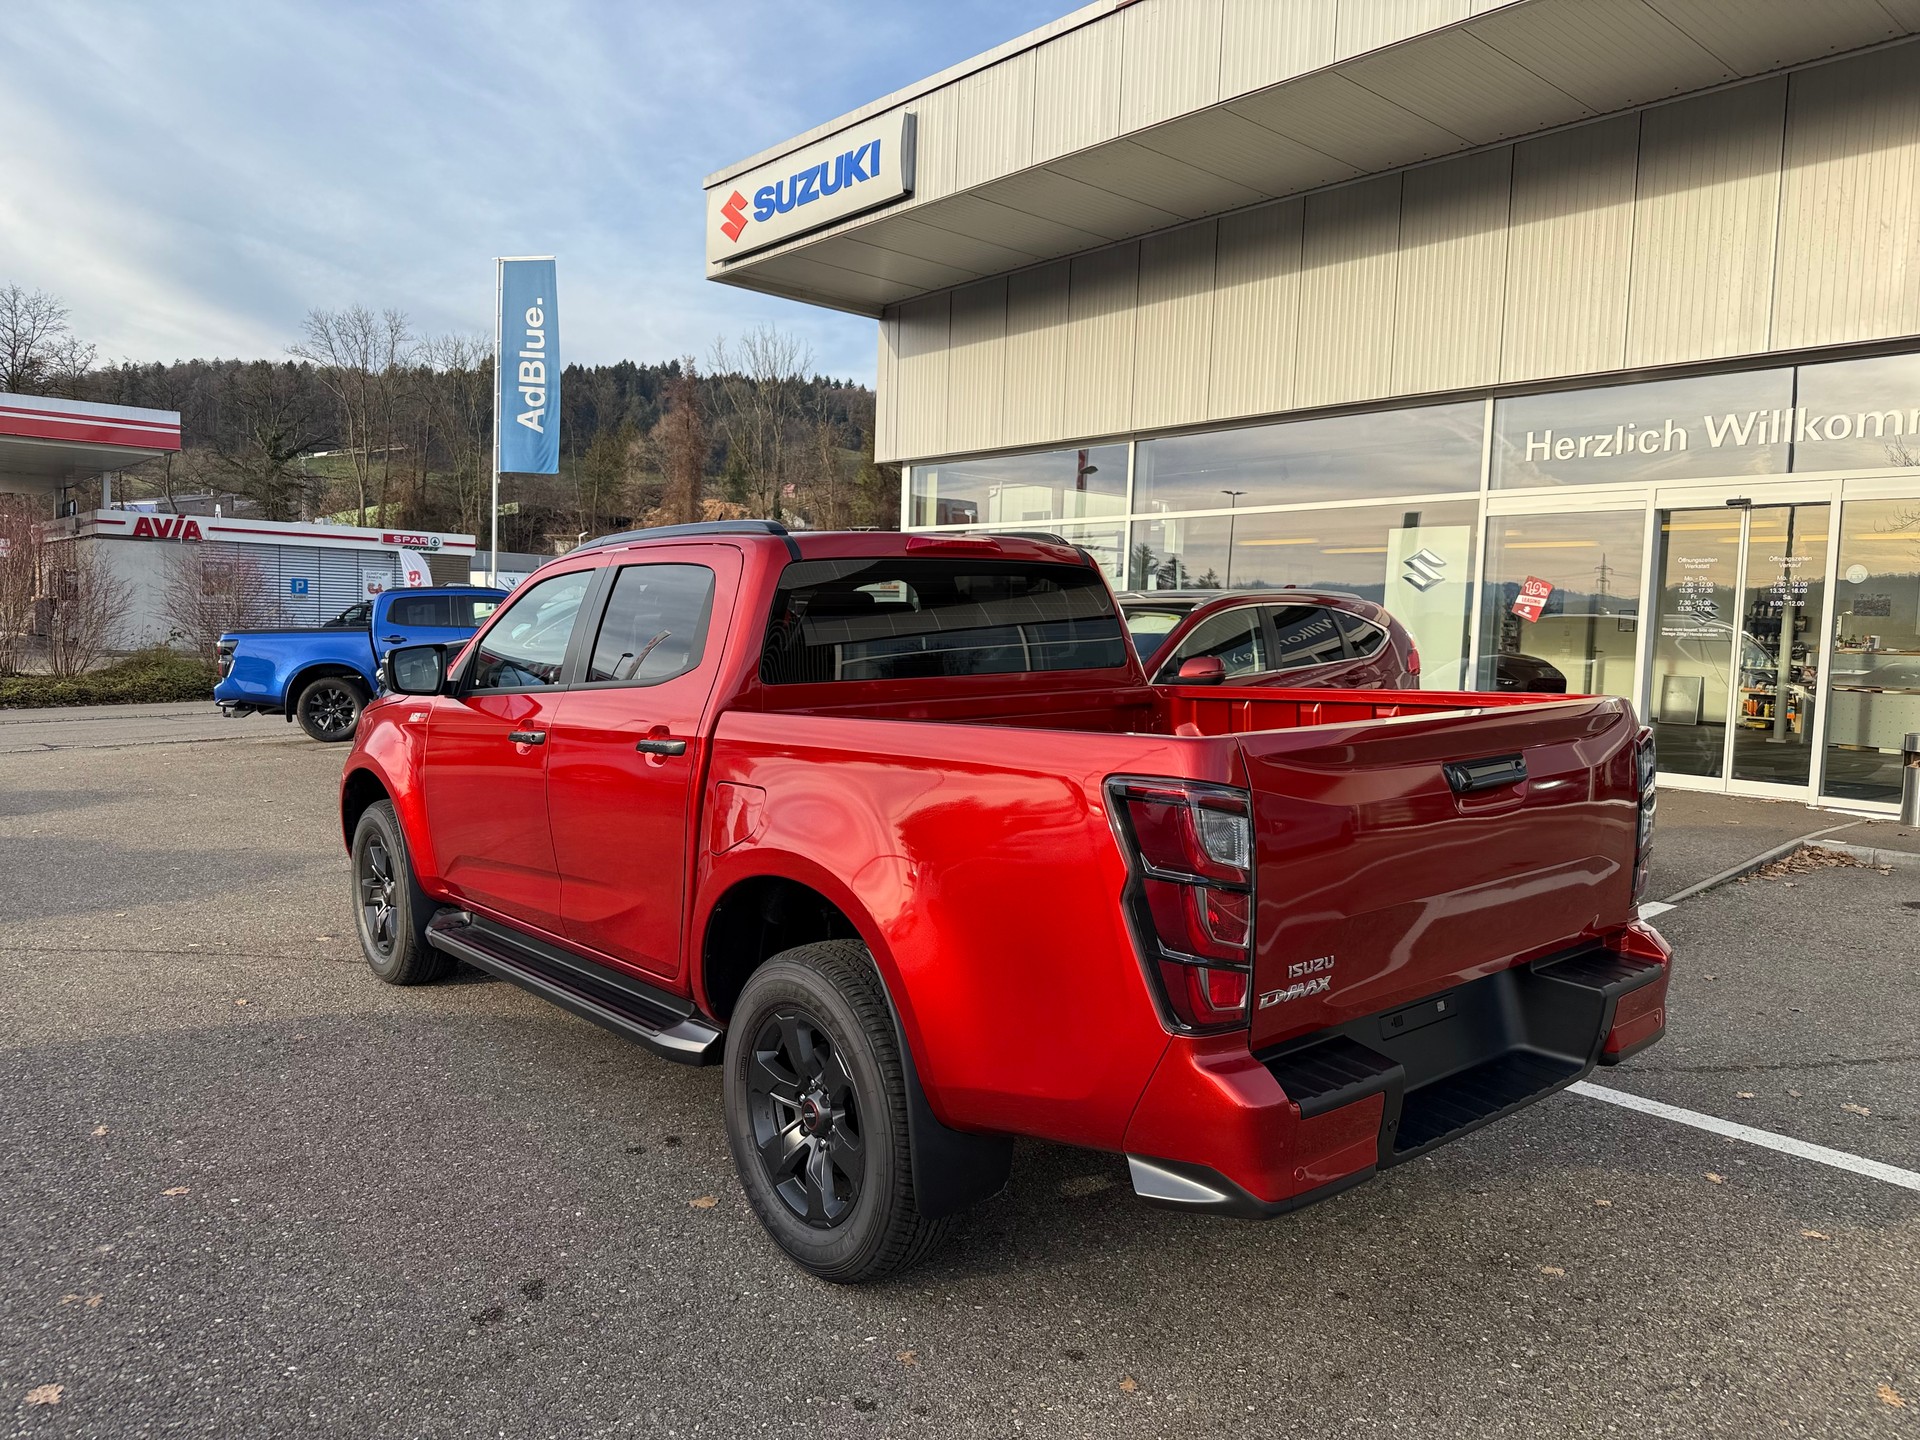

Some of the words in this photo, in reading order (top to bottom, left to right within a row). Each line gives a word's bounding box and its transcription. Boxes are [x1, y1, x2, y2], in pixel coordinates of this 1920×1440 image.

[753, 138, 881, 222] SUZUKI
[516, 297, 546, 434] AdBlue.
[1525, 419, 1688, 462] Herzlich
[132, 514, 203, 541] AVIA
[393, 535, 428, 545] SPAR
[401, 545, 440, 553] express
[1677, 556, 1718, 564] Öffnungszeiten
[1768, 555, 1813, 563] Öffnungszeiten
[1521, 597, 1542, 605] LEASING
[1288, 955, 1335, 979] ISUZU
